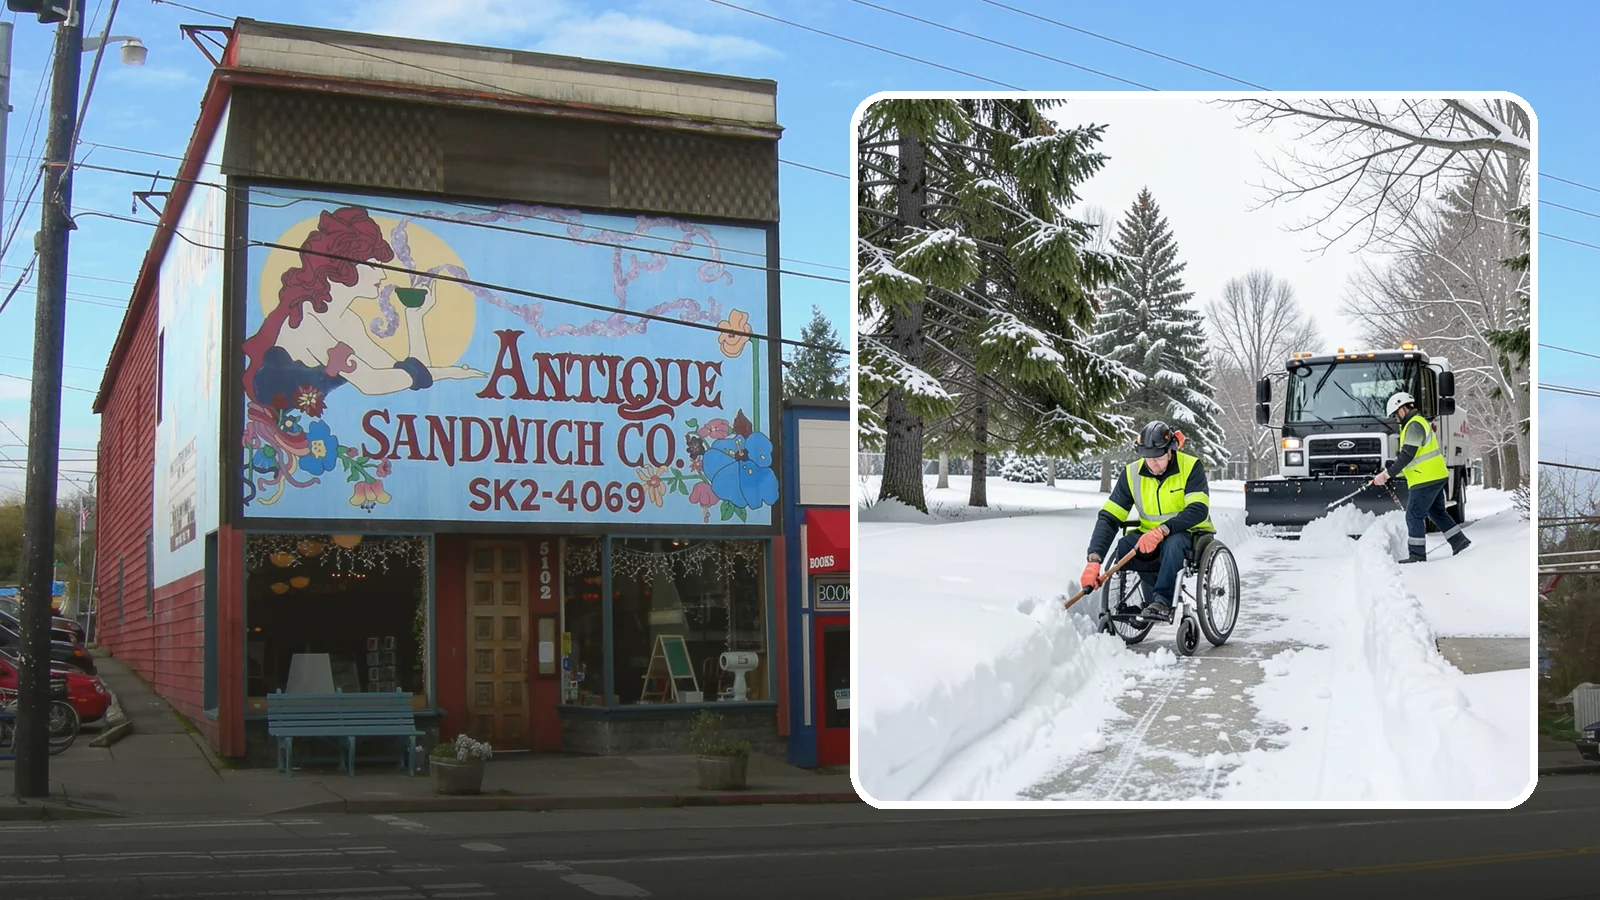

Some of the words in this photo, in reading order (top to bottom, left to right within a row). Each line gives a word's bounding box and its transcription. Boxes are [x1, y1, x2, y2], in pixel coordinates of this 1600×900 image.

[475, 328, 724, 421] ANTIQUE
[361, 408, 605, 468] SANDWICH
[617, 421, 685, 470] CO.
[468, 477, 646, 513] SK2-4069
[539, 541, 552, 600] 5102
[809, 555, 835, 569] BOOKS
